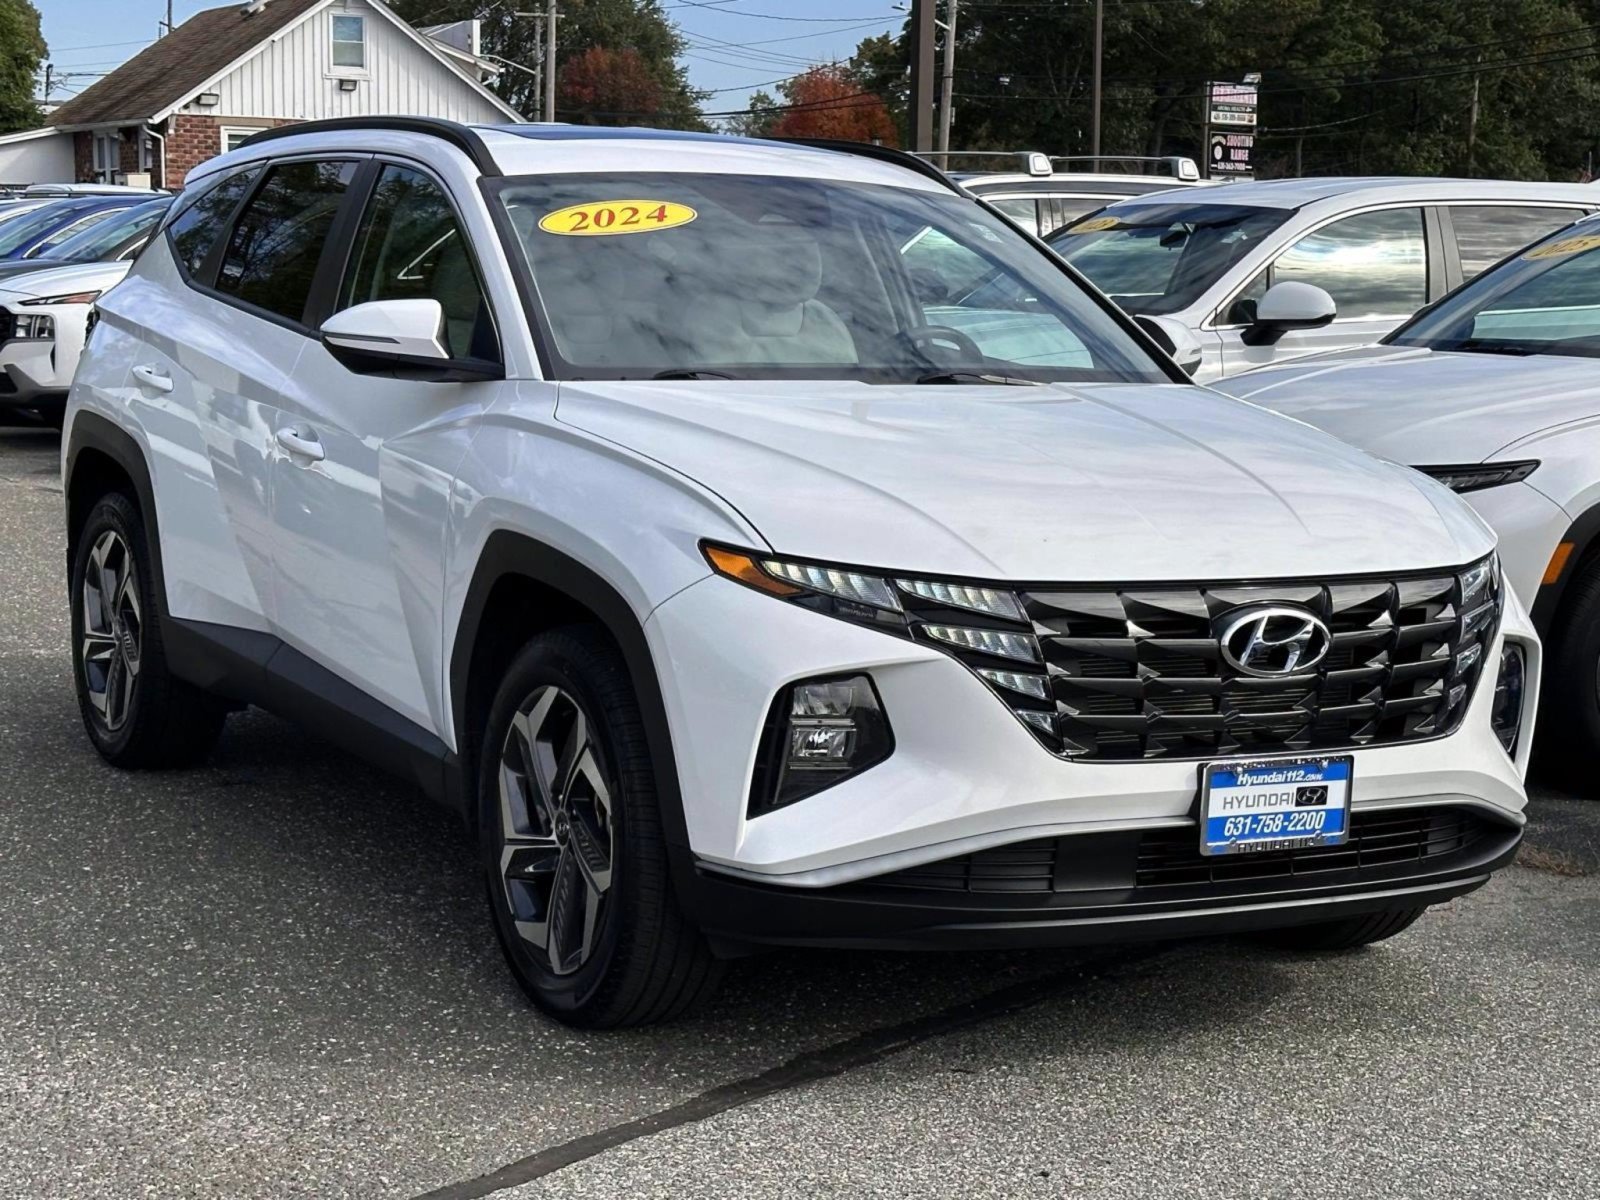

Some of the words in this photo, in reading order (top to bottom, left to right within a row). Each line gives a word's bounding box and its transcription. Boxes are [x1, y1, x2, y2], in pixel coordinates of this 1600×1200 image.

[1226, 135, 1254, 148] SHOOTING
[1230, 149, 1249, 161] RANGE
[569, 205, 668, 232] 2024
[1222, 792, 1295, 810] HYUNDAI
[1224, 811, 1326, 836] 631-758-2200
